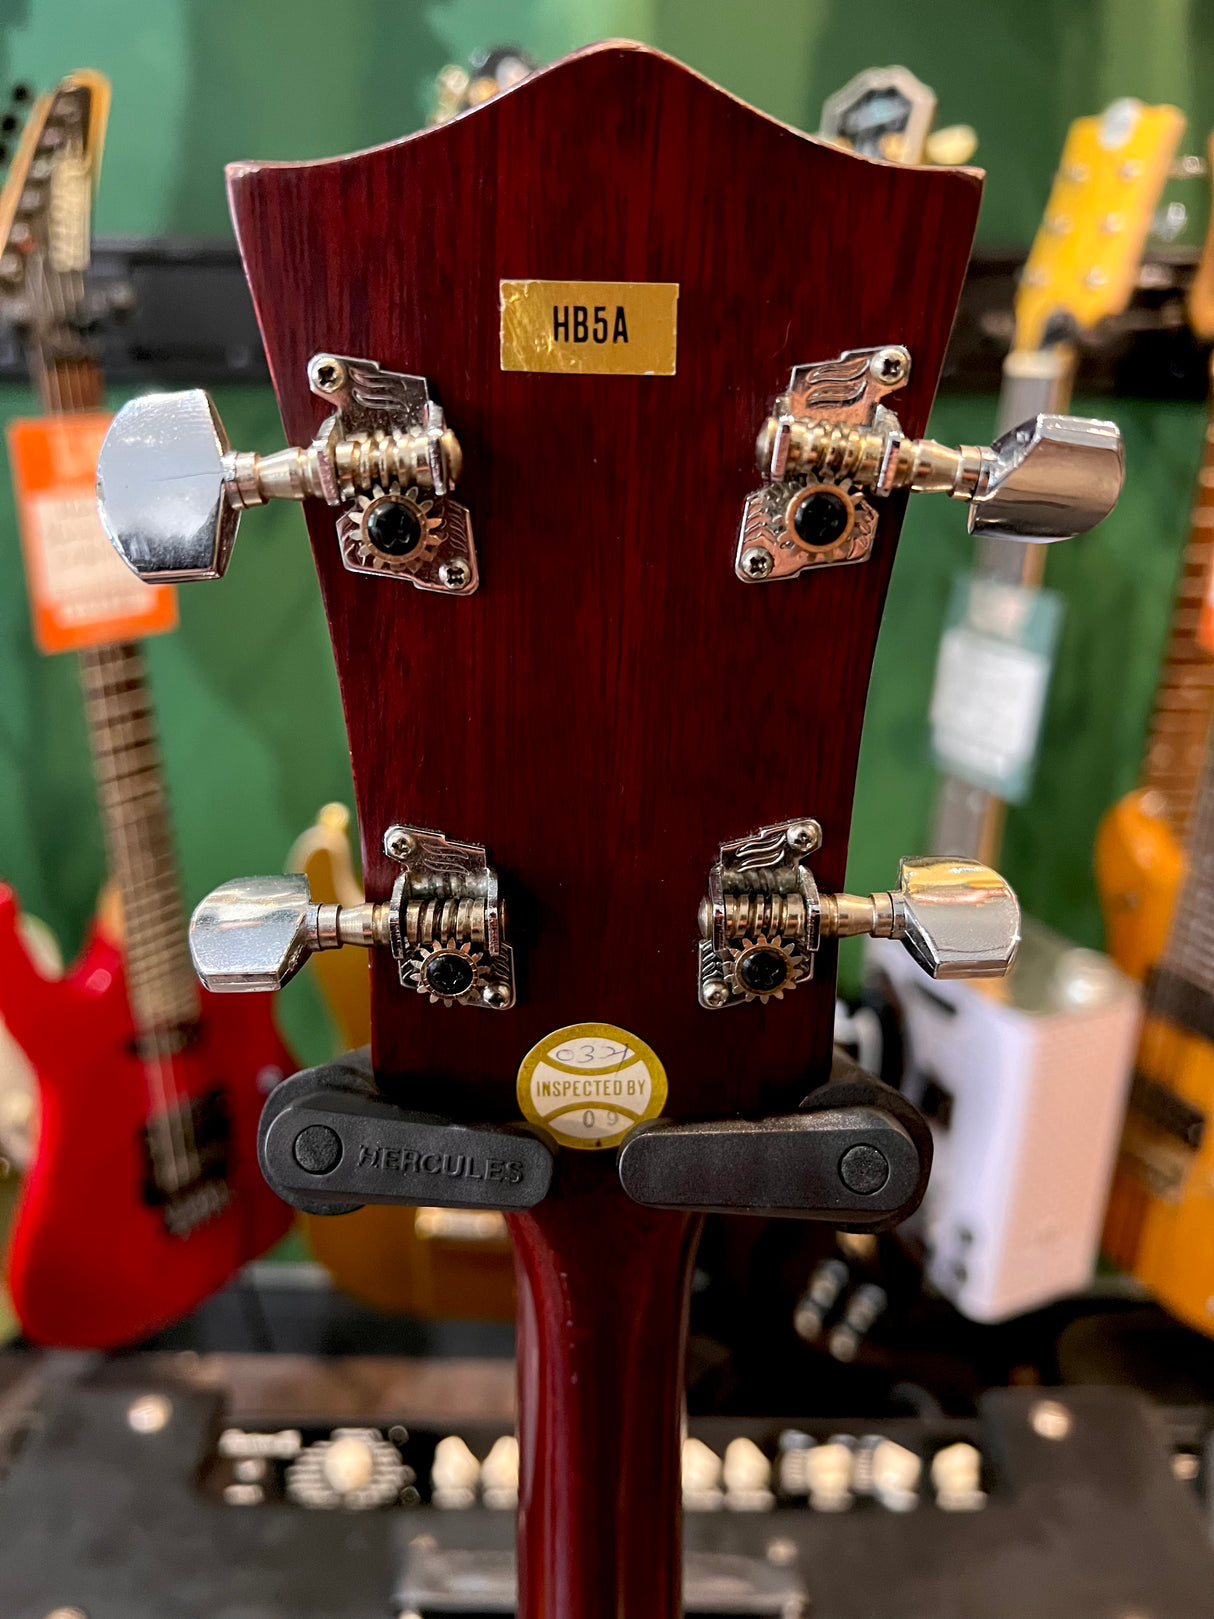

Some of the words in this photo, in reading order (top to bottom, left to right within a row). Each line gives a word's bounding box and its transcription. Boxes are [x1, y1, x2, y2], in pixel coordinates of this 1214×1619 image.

[553, 306, 629, 343] HB5A
[536, 1081, 623, 1097] INSPECTED
[627, 1079, 646, 1096] BY
[357, 1144, 525, 1183] HERCULES
